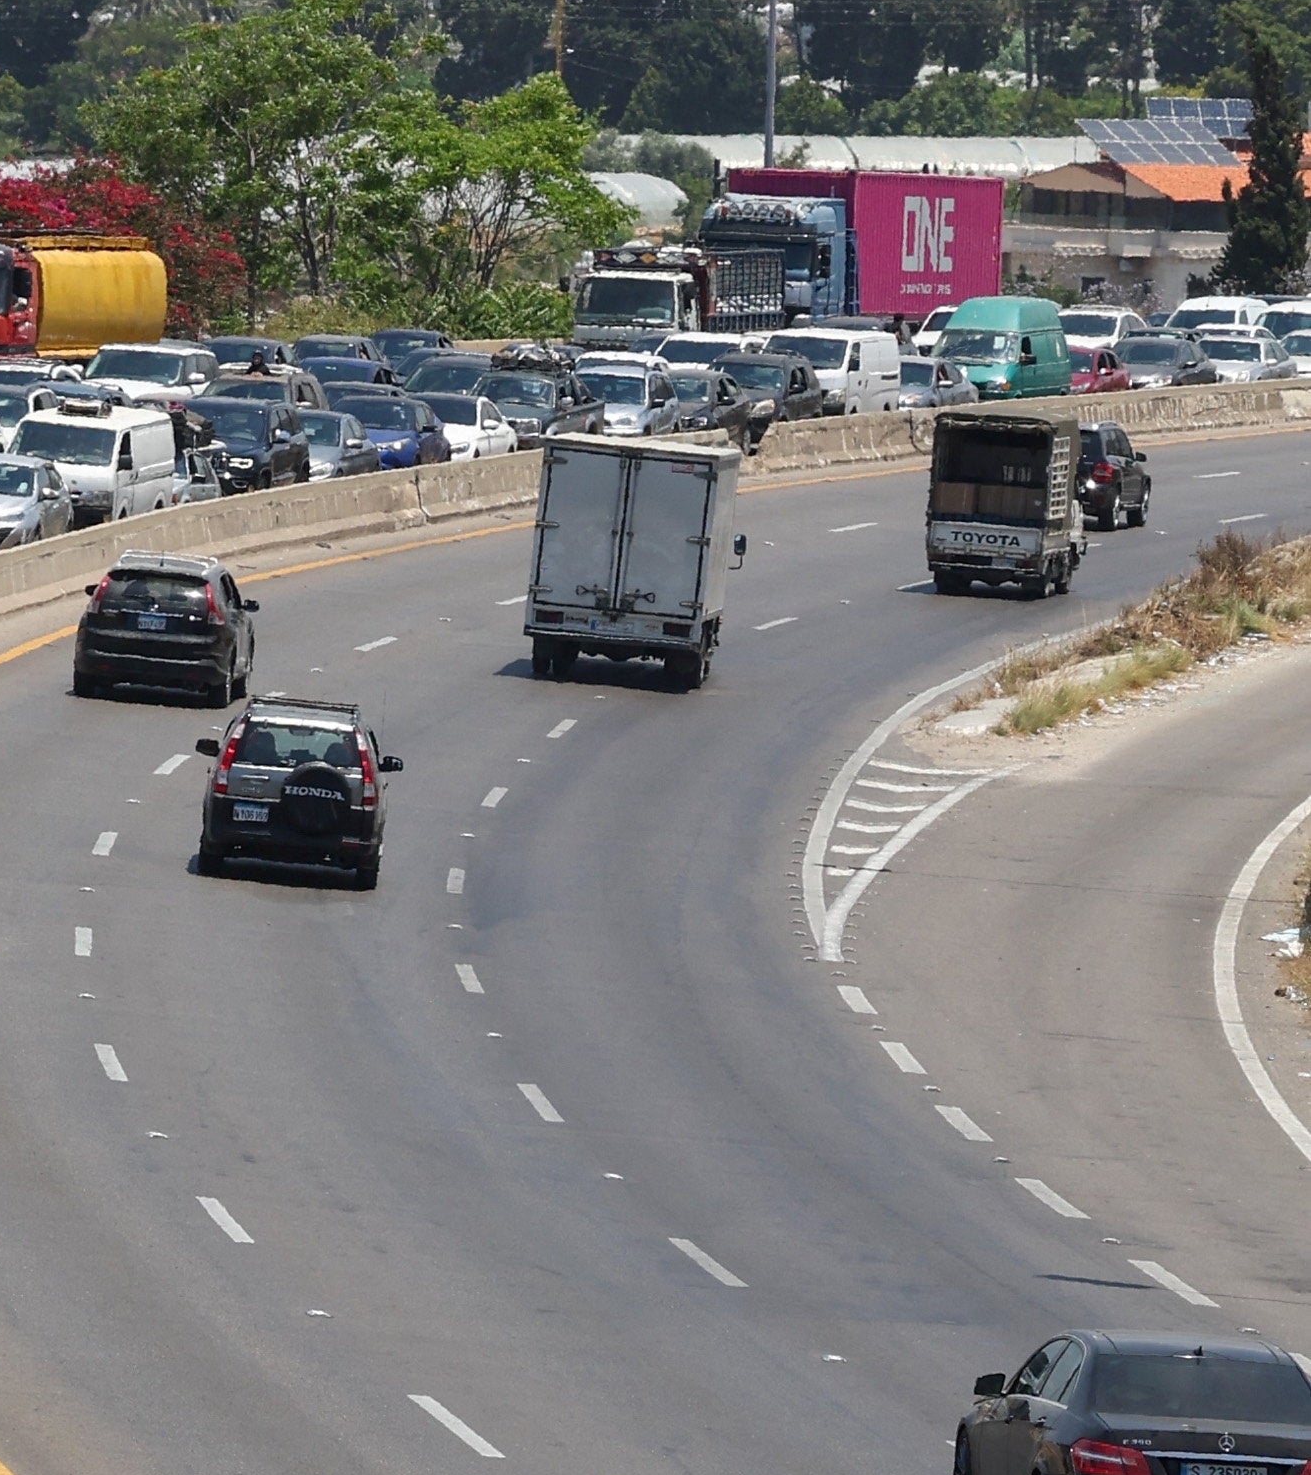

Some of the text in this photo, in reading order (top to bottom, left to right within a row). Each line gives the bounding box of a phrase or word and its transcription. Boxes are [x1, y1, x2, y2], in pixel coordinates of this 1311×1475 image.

[901, 195, 955, 273] ONE
[950, 530, 1021, 547] TOYOTA
[284, 784, 346, 802] HONDA
